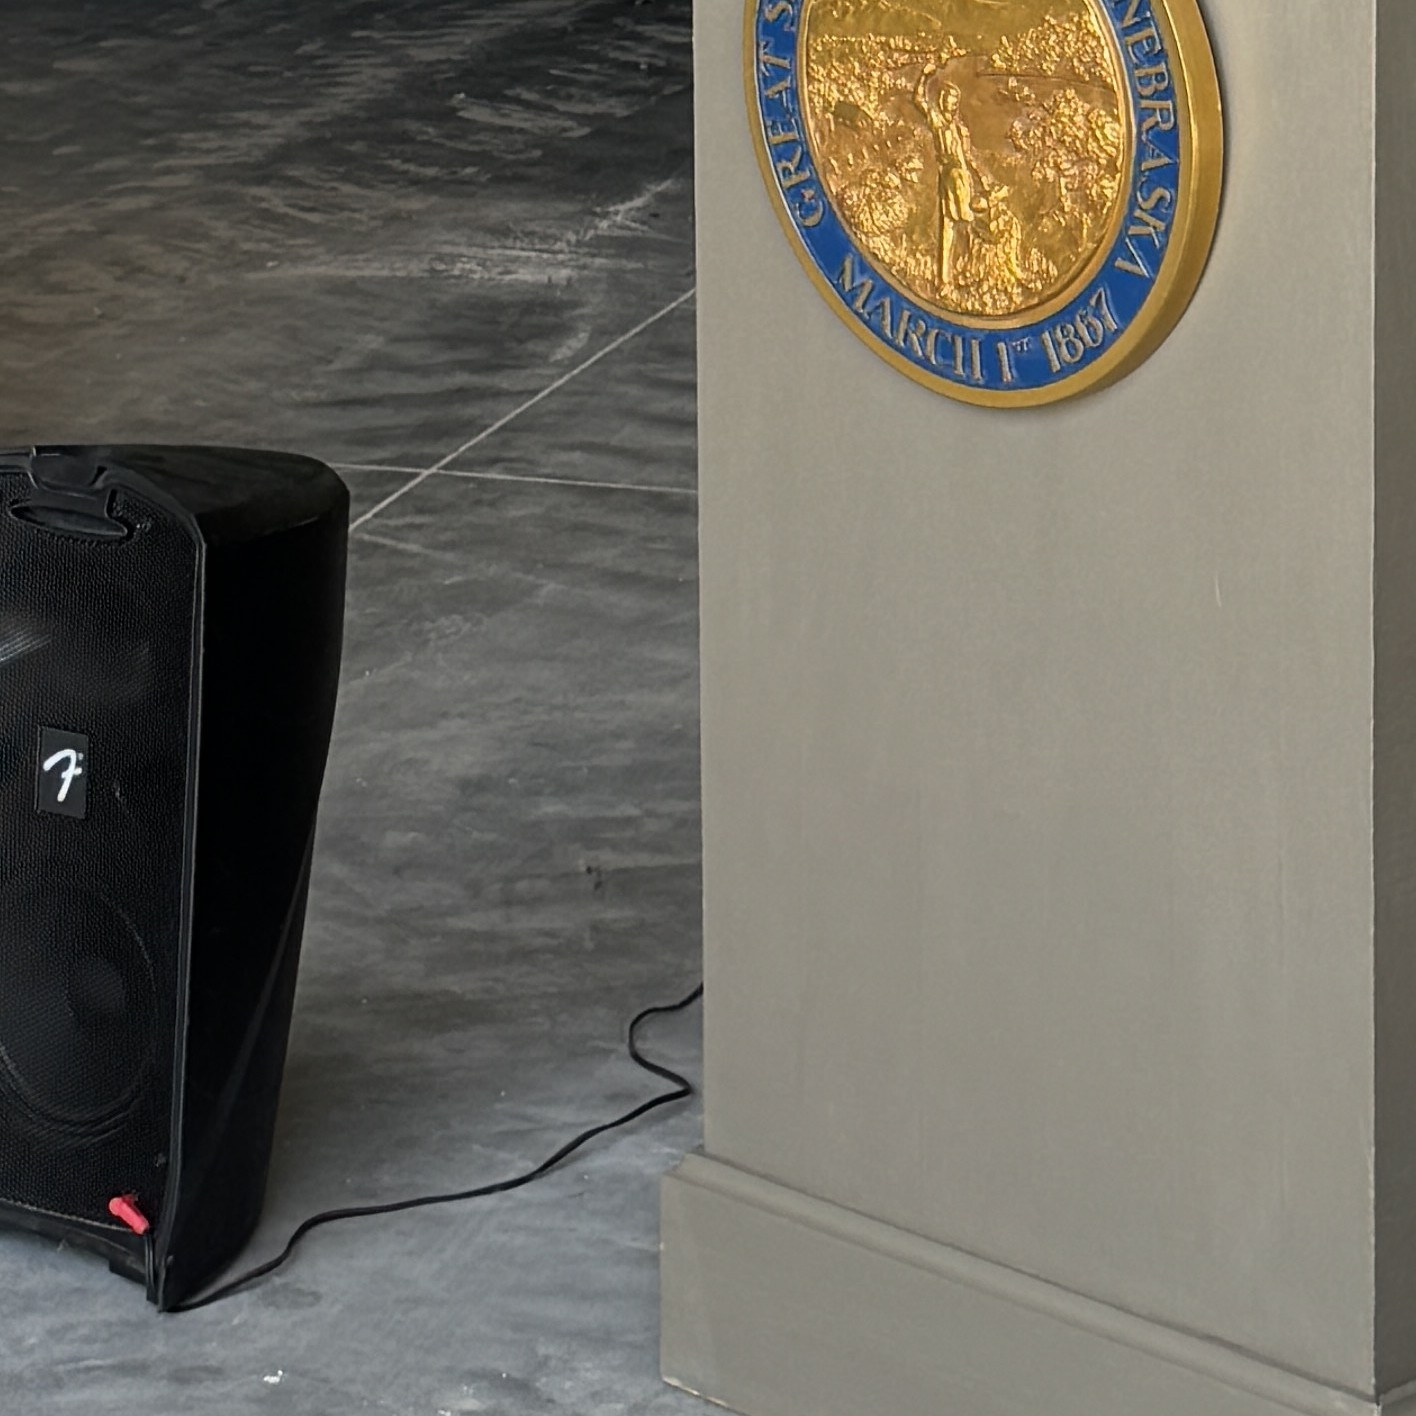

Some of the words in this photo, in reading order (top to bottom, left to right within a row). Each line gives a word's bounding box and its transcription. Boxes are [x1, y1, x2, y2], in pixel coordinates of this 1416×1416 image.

[758, 39, 825, 228] GREAT
[831, 253, 984, 385] MARCH
[1041, 286, 1120, 374] 1867
